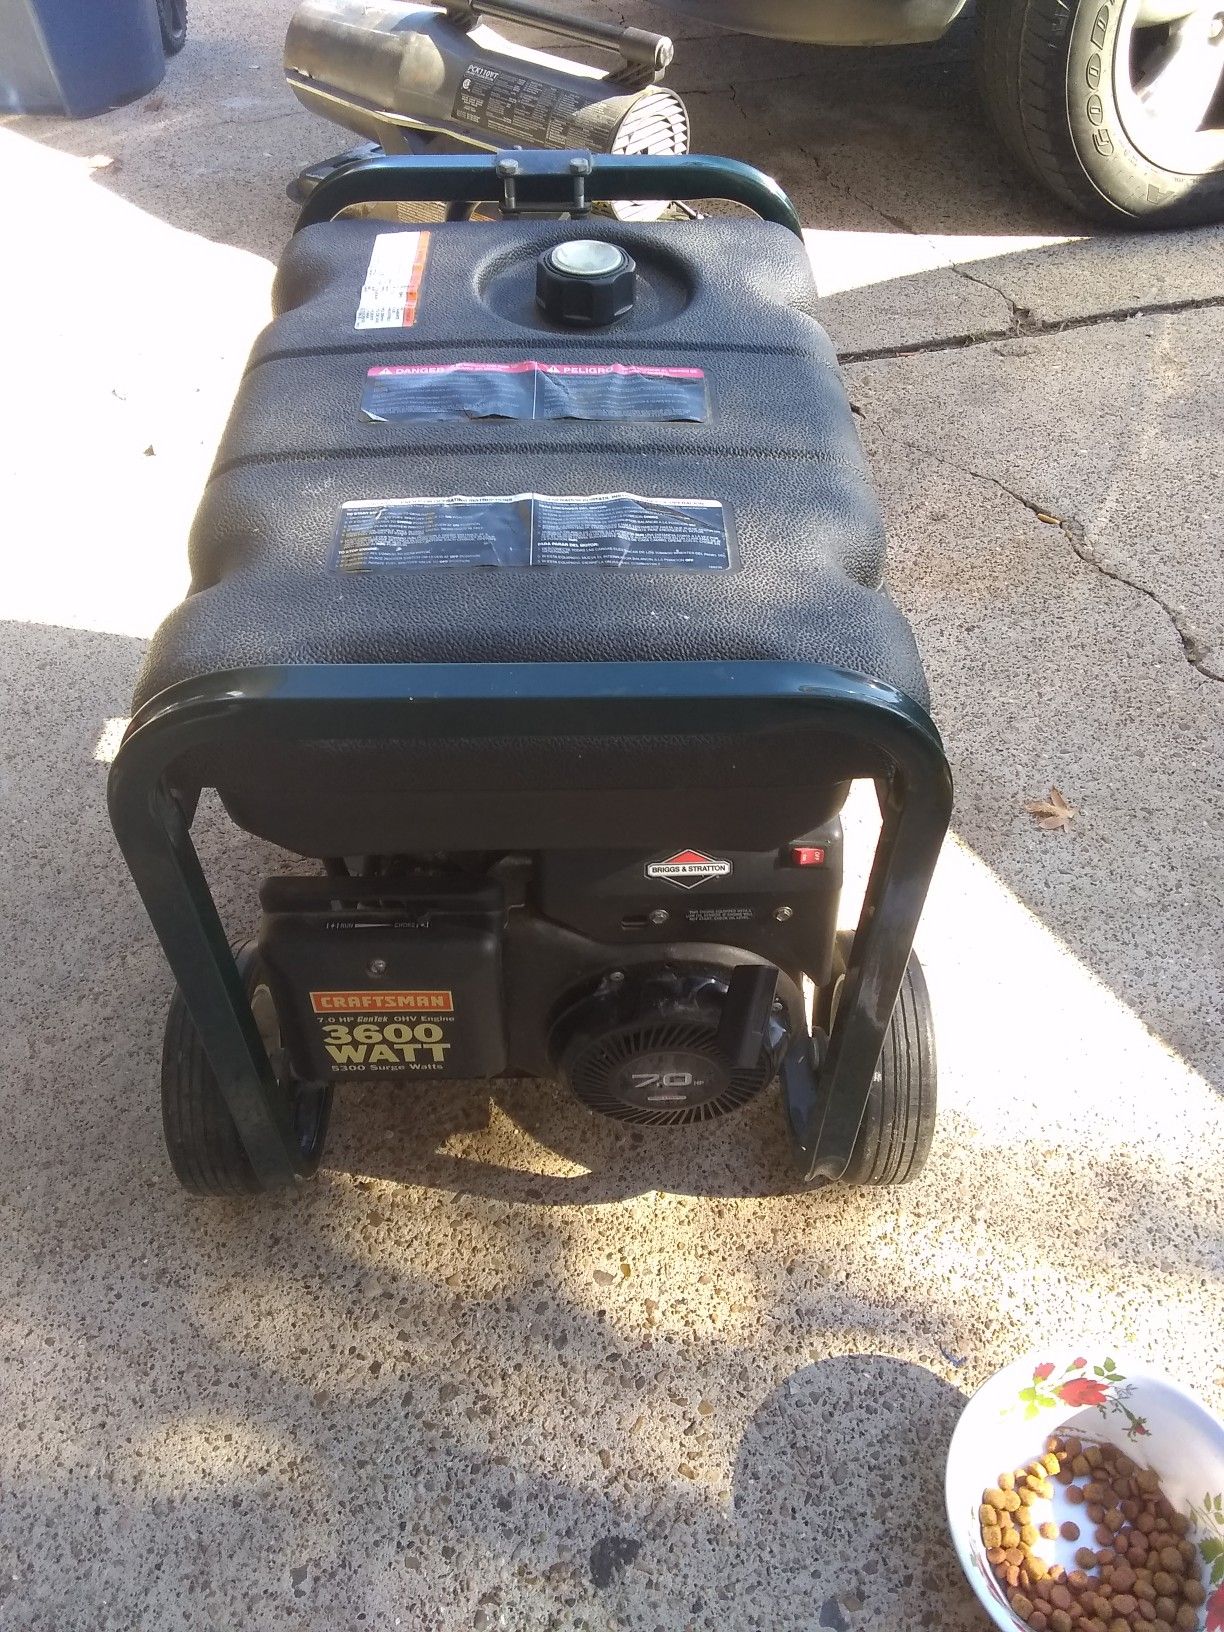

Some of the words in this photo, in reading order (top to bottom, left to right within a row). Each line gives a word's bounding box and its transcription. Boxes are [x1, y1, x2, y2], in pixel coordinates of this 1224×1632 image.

[1085, 0, 1116, 157] GOOD
[395, 367, 445, 375] DANGER
[652, 865, 680, 874] BRIGGS
[681, 865, 687, 873] &
[688, 864, 726, 873] STRATTON
[320, 995, 444, 1008] CRAFTSMAN
[420, 1016, 455, 1024] Engine
[321, 1023, 443, 1044] 3600
[324, 1043, 451, 1064] WATT
[331, 1064, 366, 1072] 5300
[370, 1064, 405, 1073] Surge
[410, 1063, 443, 1071] Watts
[631, 1072, 693, 1088] 7.0
